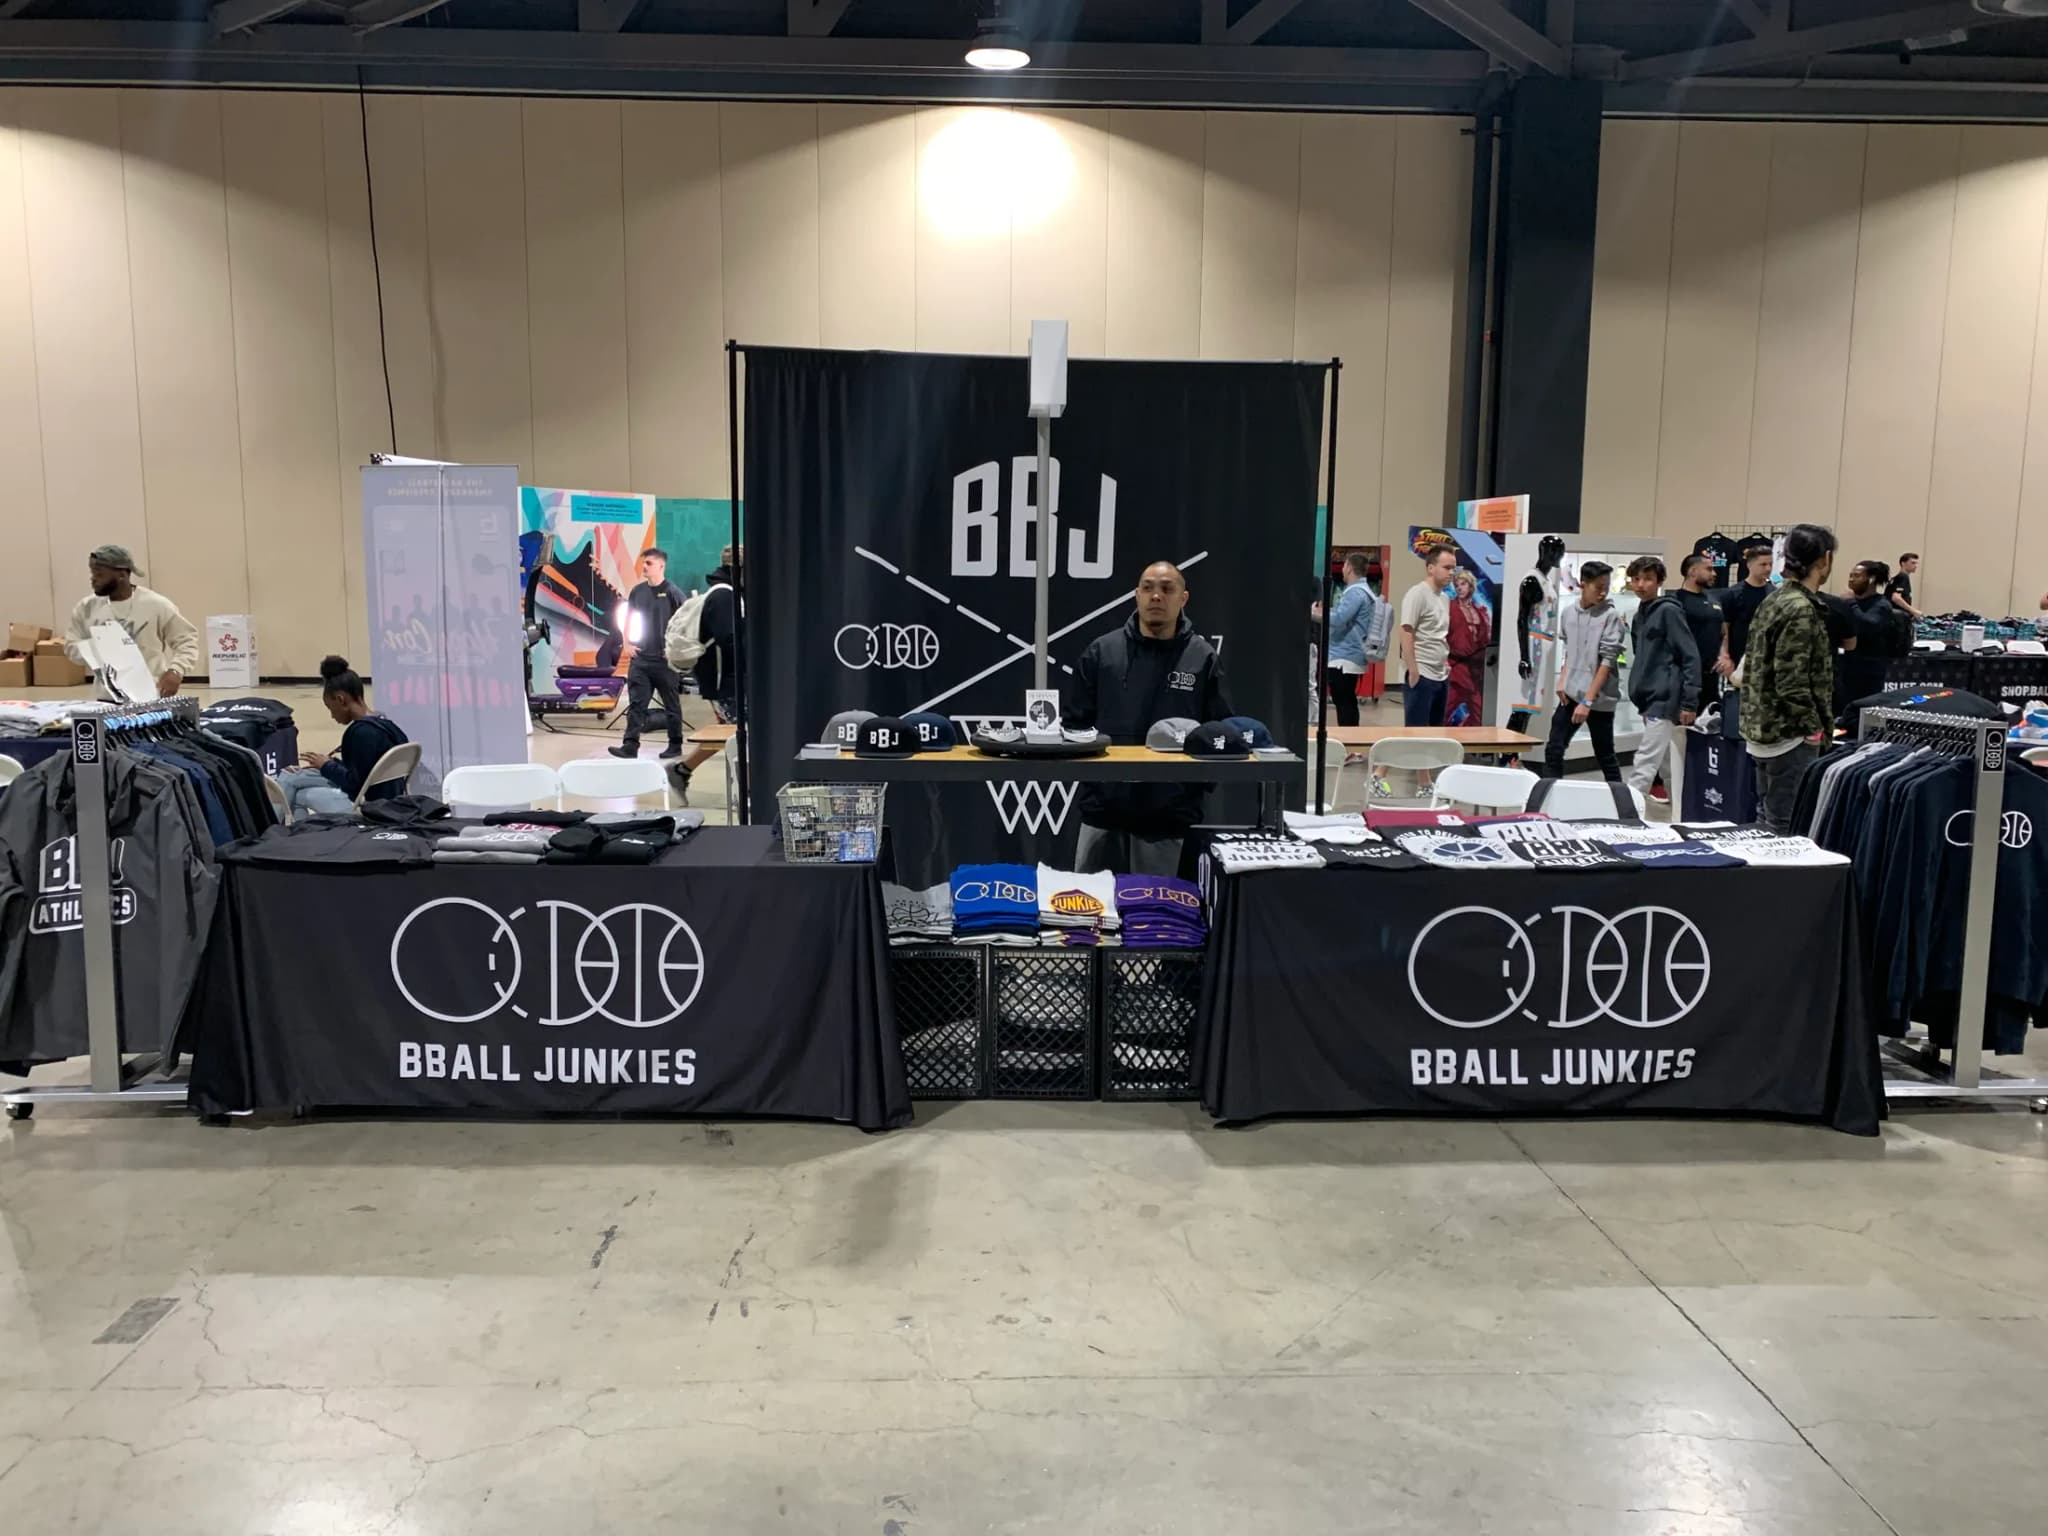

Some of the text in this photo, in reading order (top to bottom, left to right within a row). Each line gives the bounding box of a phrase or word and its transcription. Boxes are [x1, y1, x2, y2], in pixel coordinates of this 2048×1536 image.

[951, 455, 1117, 579] BBJ
[869, 728, 899, 748] BBJ
[914, 723, 939, 742] BJ
[1227, 852, 1317, 863] JUNKIES
[1522, 838, 1602, 859] BBJ
[38, 895, 131, 924] ATHLCS
[1052, 895, 1102, 911] JUNKIES
[400, 1041, 697, 1085] BBALL JUNKIES
[1410, 1047, 1696, 1085] BBALL JUNKIES
